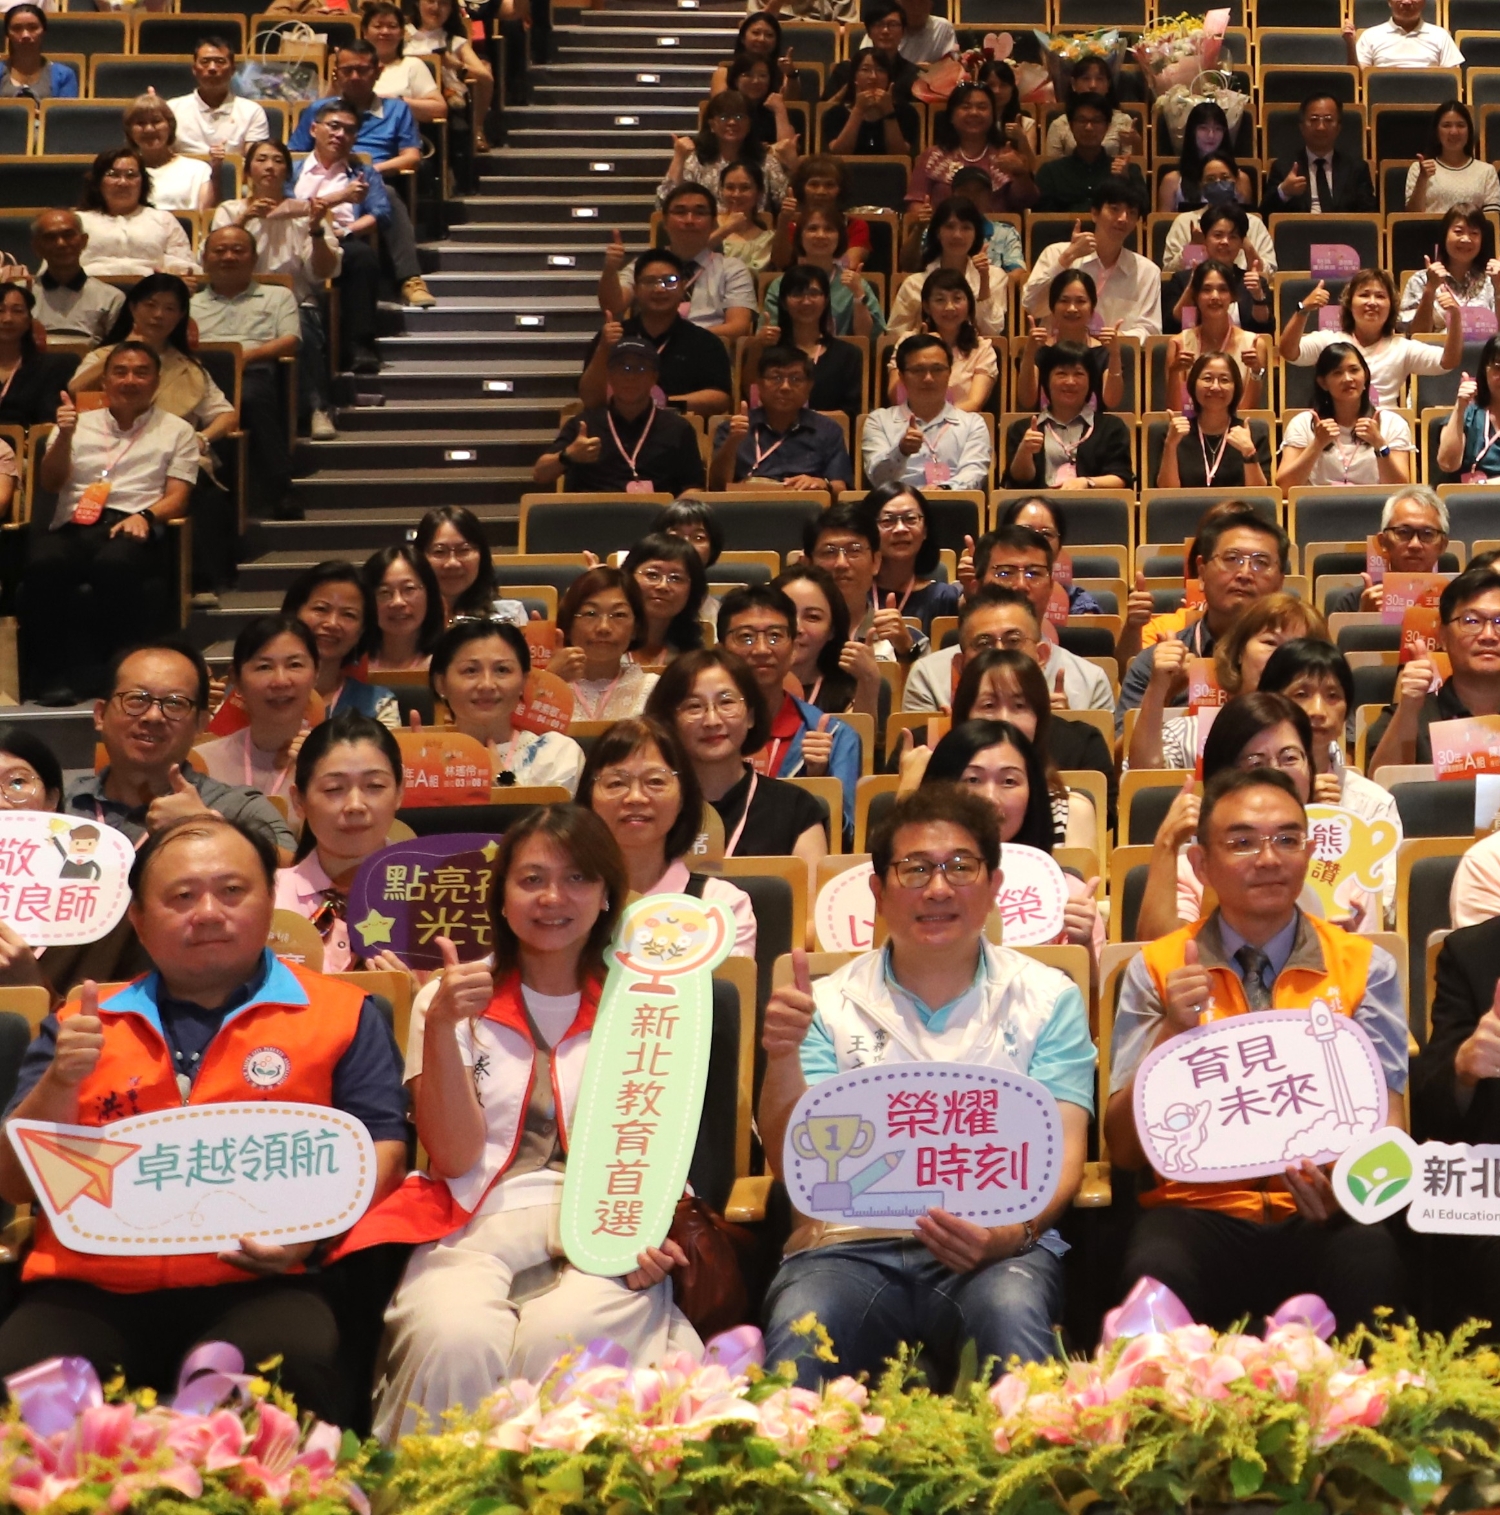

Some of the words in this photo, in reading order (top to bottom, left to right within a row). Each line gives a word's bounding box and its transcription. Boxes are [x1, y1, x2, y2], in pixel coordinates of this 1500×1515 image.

[414, 769, 439, 788] A組
[1178, 1034, 1287, 1089] 育見
[591, 1002, 681, 1238] 新北教育首選
[887, 1089, 1000, 1139] 榮耀
[1218, 1073, 1325, 1126] 未來
[133, 1128, 340, 1191] 卓越領航
[916, 1141, 1030, 1192] 時刻
[1422, 1208, 1435, 1219] AI
